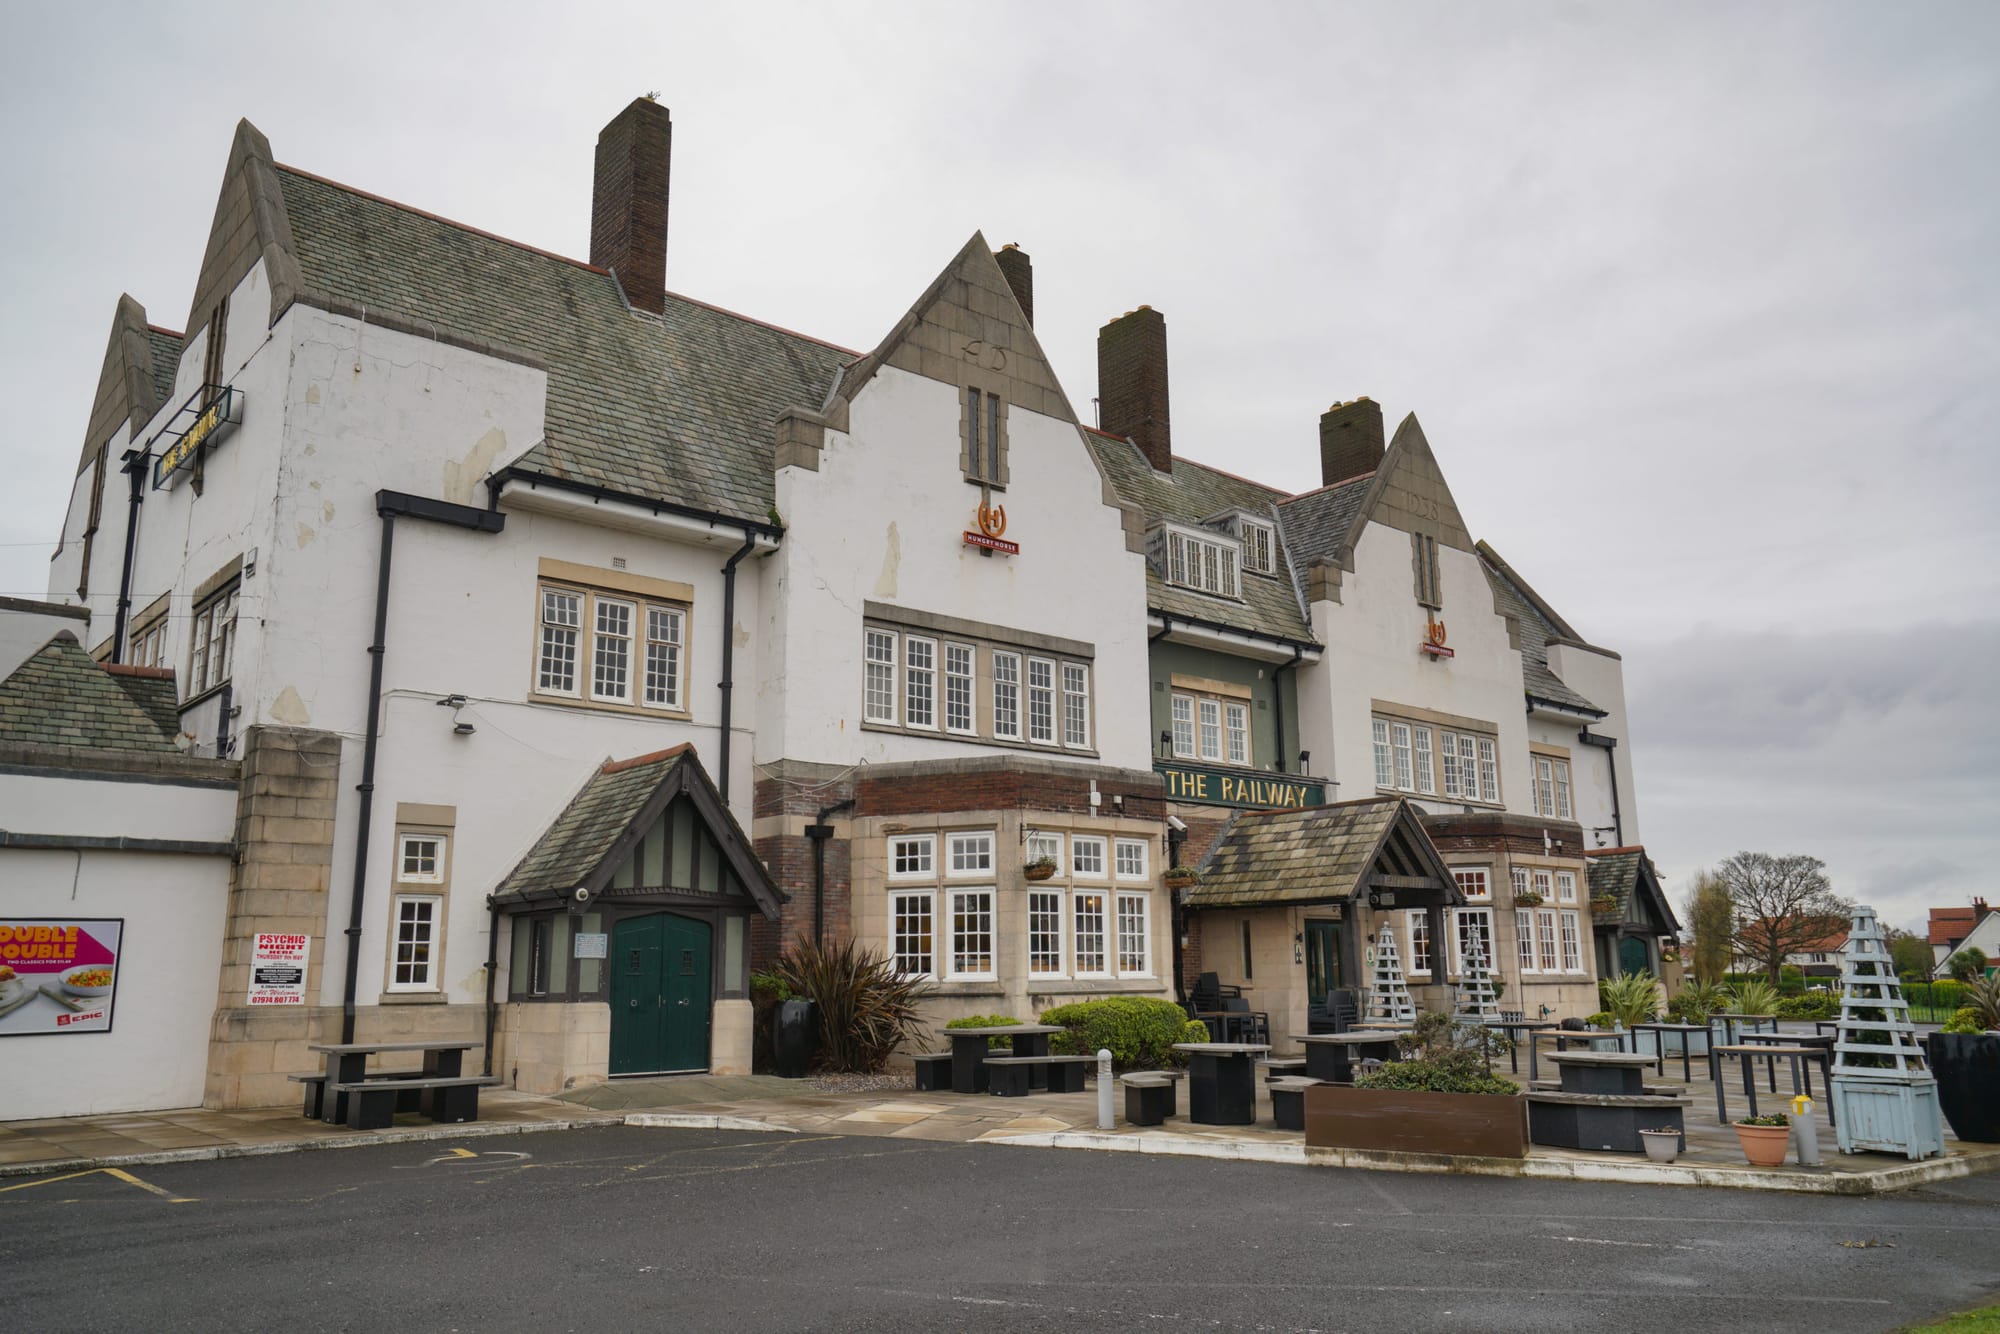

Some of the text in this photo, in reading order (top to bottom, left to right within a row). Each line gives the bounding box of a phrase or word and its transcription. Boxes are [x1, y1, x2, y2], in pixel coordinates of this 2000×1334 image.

[967, 534, 1016, 551] HUNGRY HORSE
[1166, 771, 1307, 808] THE RAILWAY
[259, 934, 306, 944] PSYCHIC
[0, 944, 77, 958] OUBLE
[72, 1011, 102, 1023] EPIC
